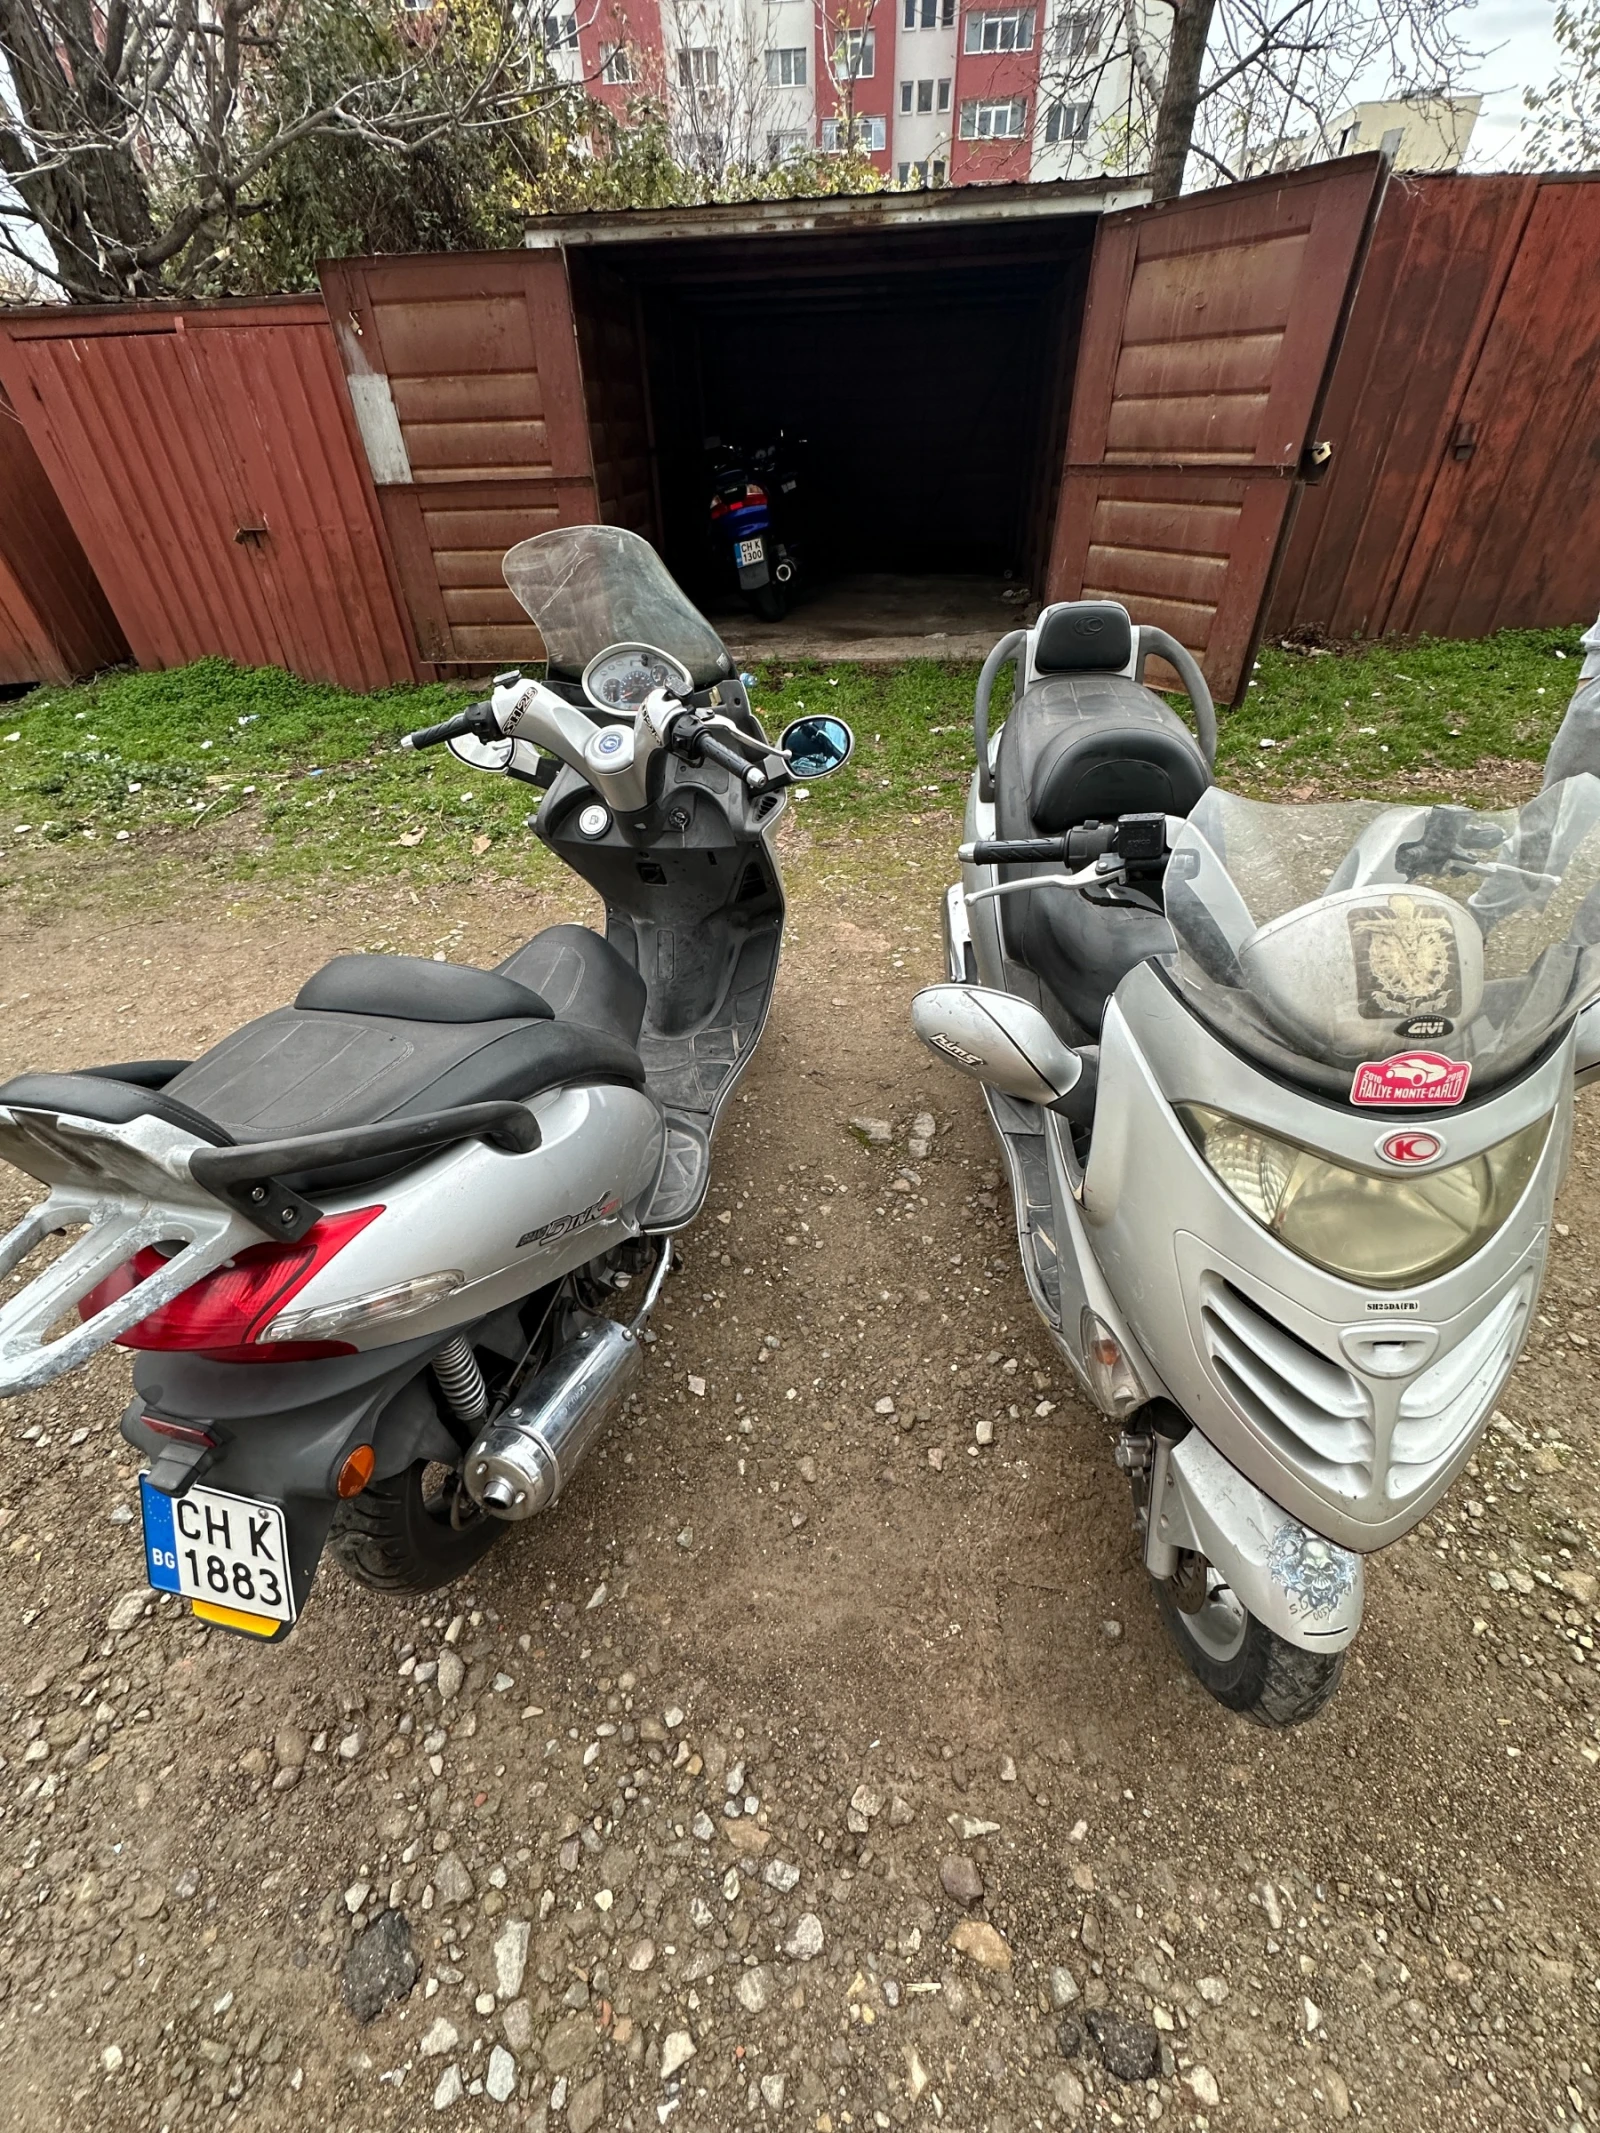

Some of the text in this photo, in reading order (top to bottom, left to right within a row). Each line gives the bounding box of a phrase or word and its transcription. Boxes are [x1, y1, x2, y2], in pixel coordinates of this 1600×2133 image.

[741, 540, 761, 553] CH K
[743, 550, 763, 562] 1300
[1408, 1021, 1444, 1034] GIVI
[1363, 1070, 1383, 1084] 2010
[1358, 1078, 1462, 1099] RALLYE MONTE-CARLO
[1366, 1302, 1419, 1311] SH25DA(FR)
[176, 1499, 275, 1562] CH K
[152, 1547, 176, 1570] BG
[184, 1548, 283, 1607] 1883
